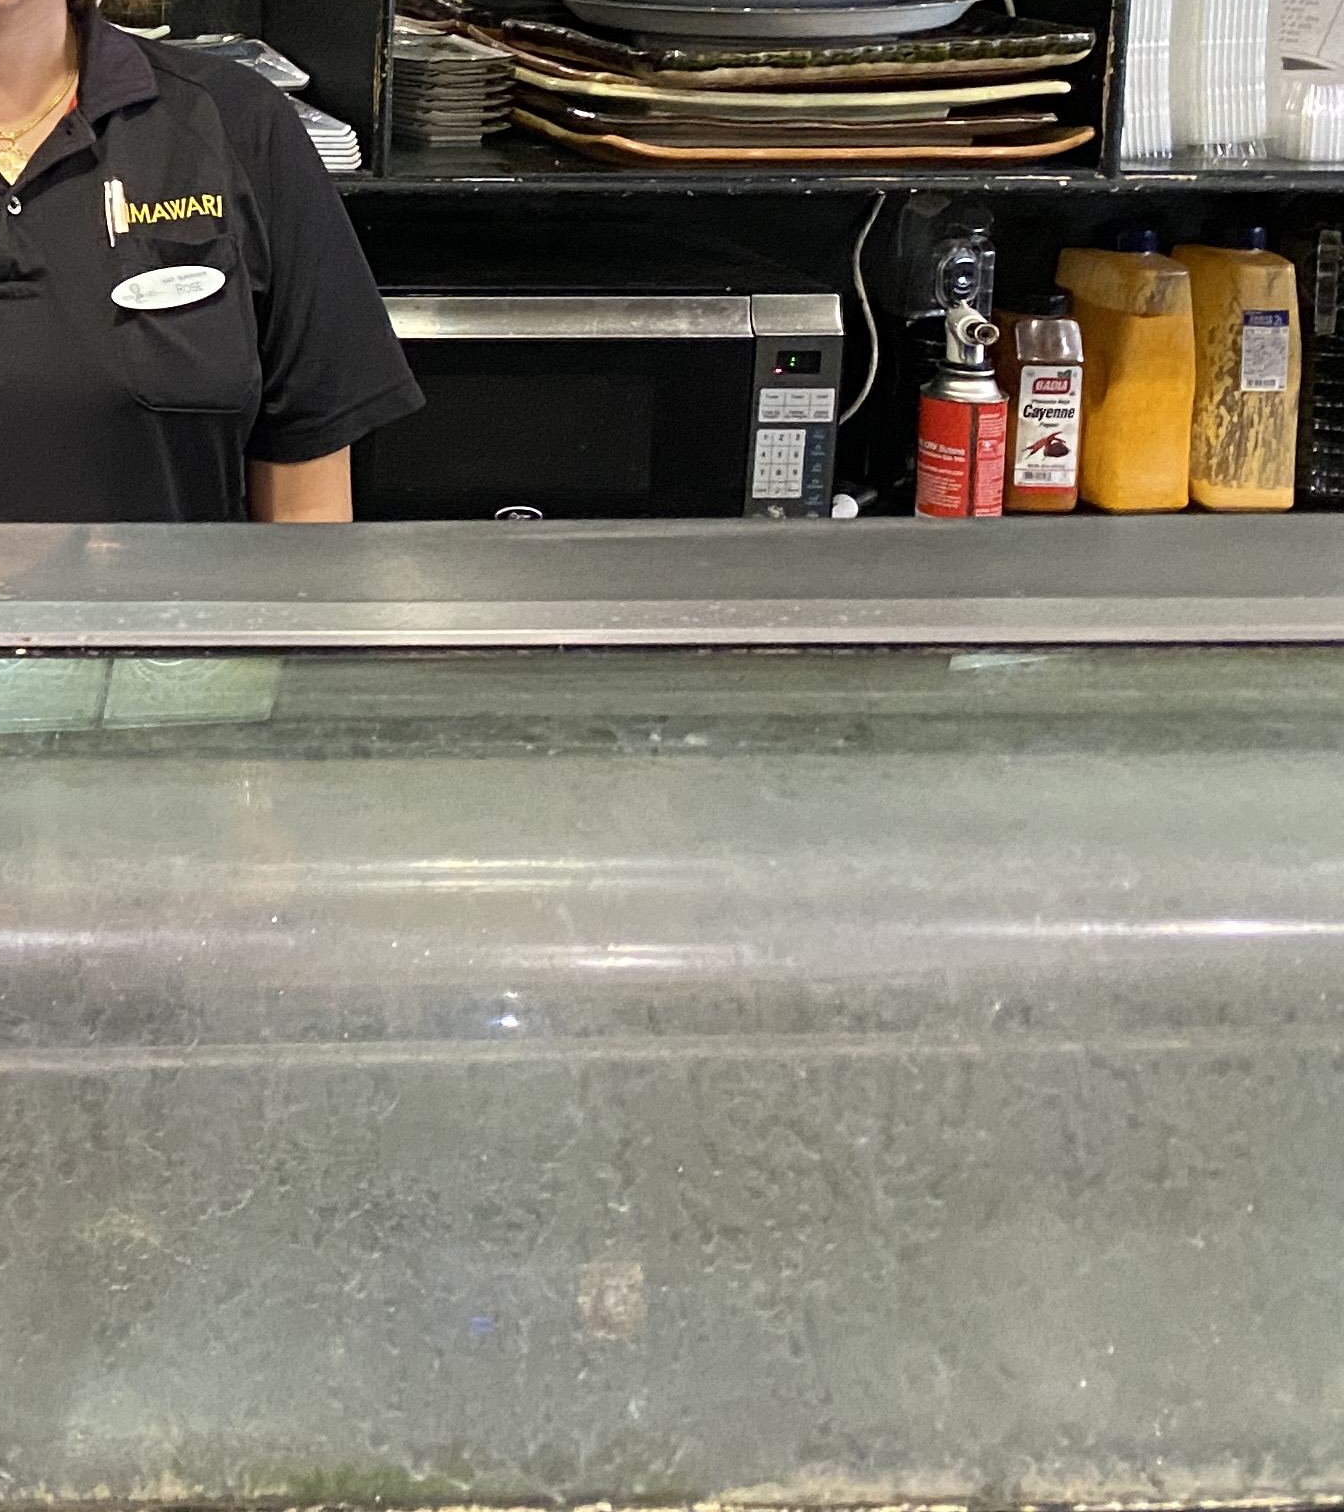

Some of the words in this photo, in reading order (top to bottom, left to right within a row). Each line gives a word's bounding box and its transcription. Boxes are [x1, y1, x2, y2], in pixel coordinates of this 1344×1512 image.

[174, 281, 204, 295] ROSE
[1035, 379, 1069, 392] BADIA
[1022, 404, 1076, 422] Cayenne
